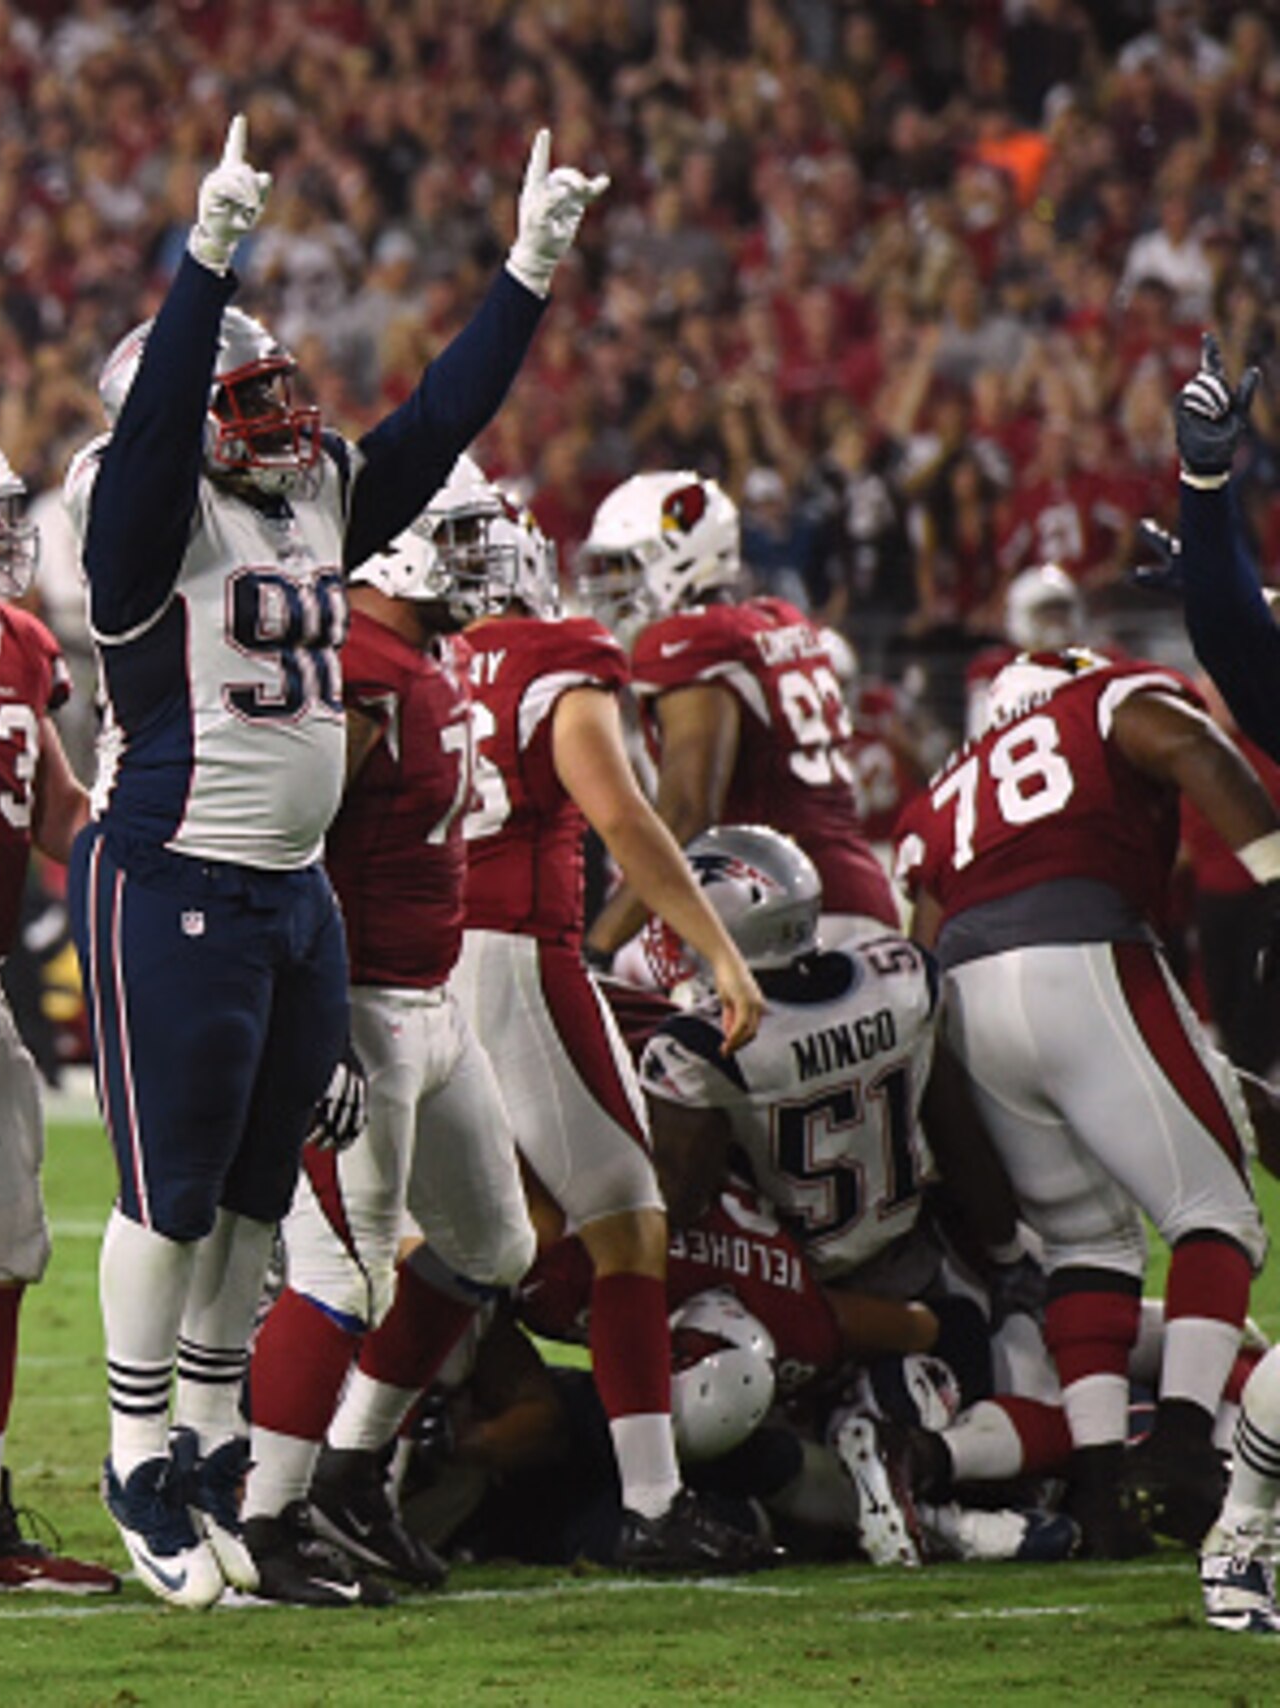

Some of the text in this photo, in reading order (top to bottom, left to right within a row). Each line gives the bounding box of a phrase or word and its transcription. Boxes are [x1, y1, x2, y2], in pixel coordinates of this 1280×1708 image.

[777, 667, 854, 785] 93
[931, 714, 1075, 872] 78
[790, 1008, 897, 1082] MINGO
[769, 1056, 922, 1247] 51
